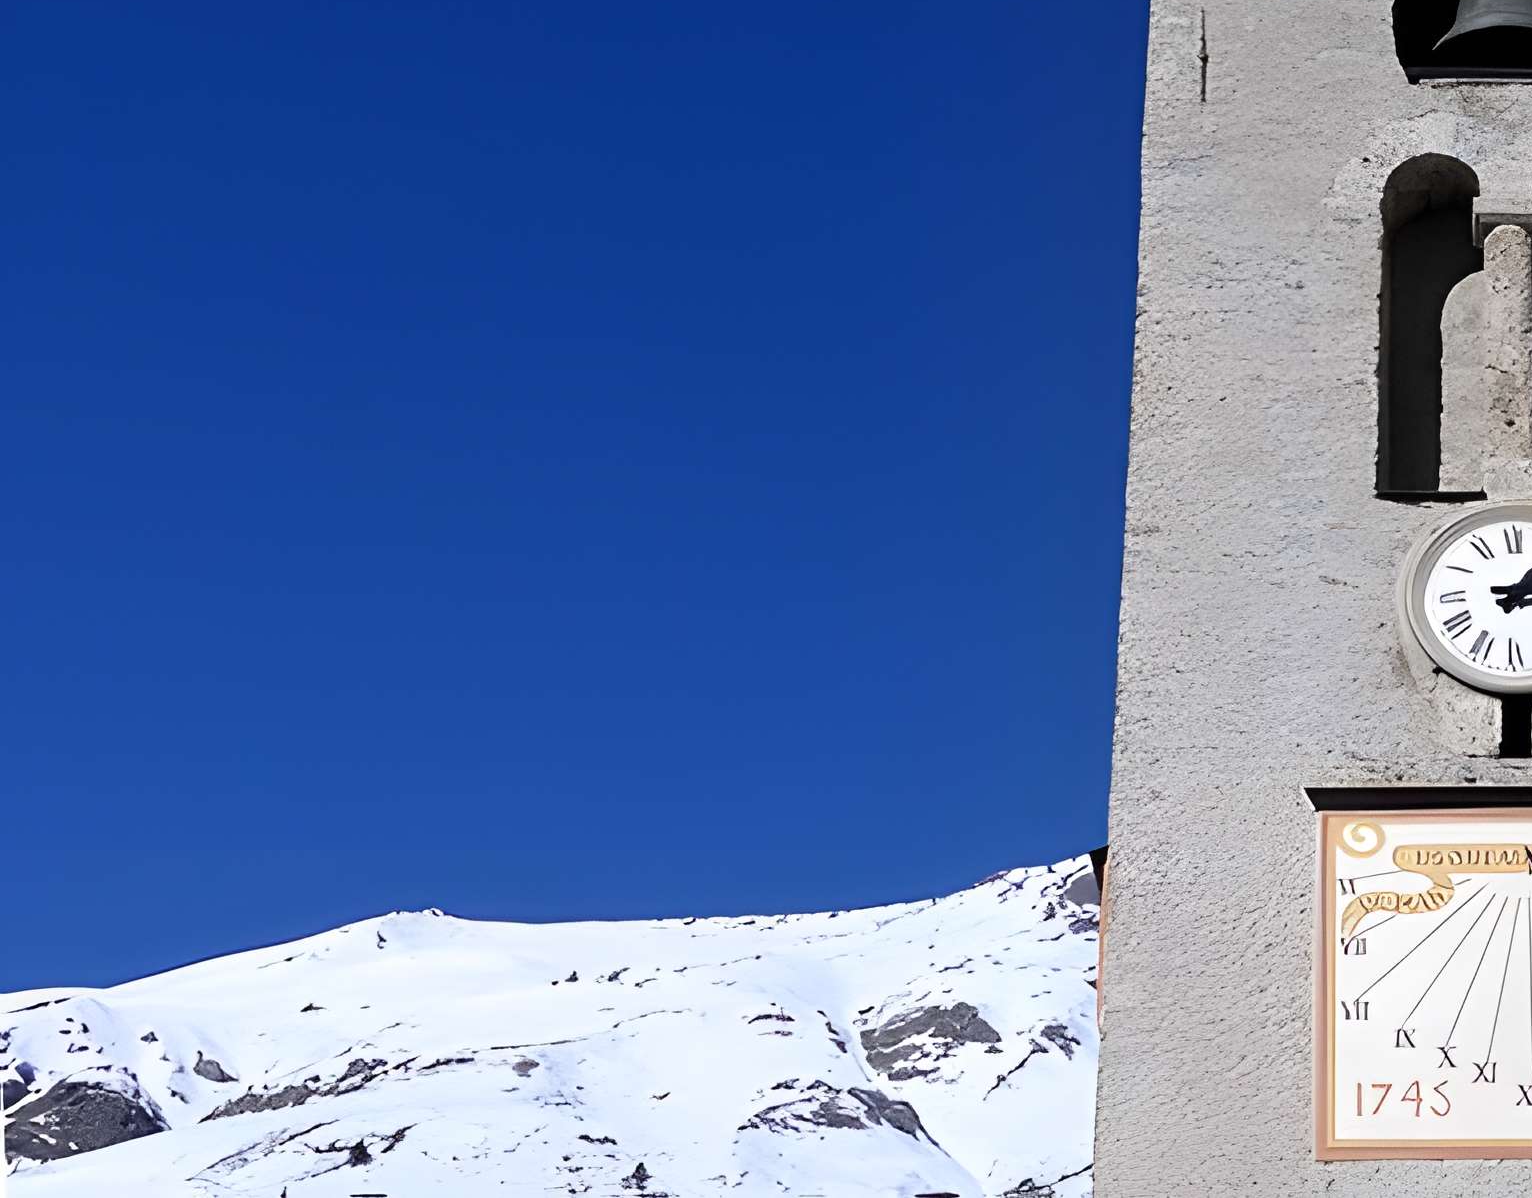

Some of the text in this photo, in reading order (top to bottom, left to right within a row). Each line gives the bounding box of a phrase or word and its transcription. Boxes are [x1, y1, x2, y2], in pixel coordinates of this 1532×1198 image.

[1436, 1046, 1457, 1069] X
[1471, 1062, 1497, 1083] XI
[1356, 1080, 1451, 1117] 1745
